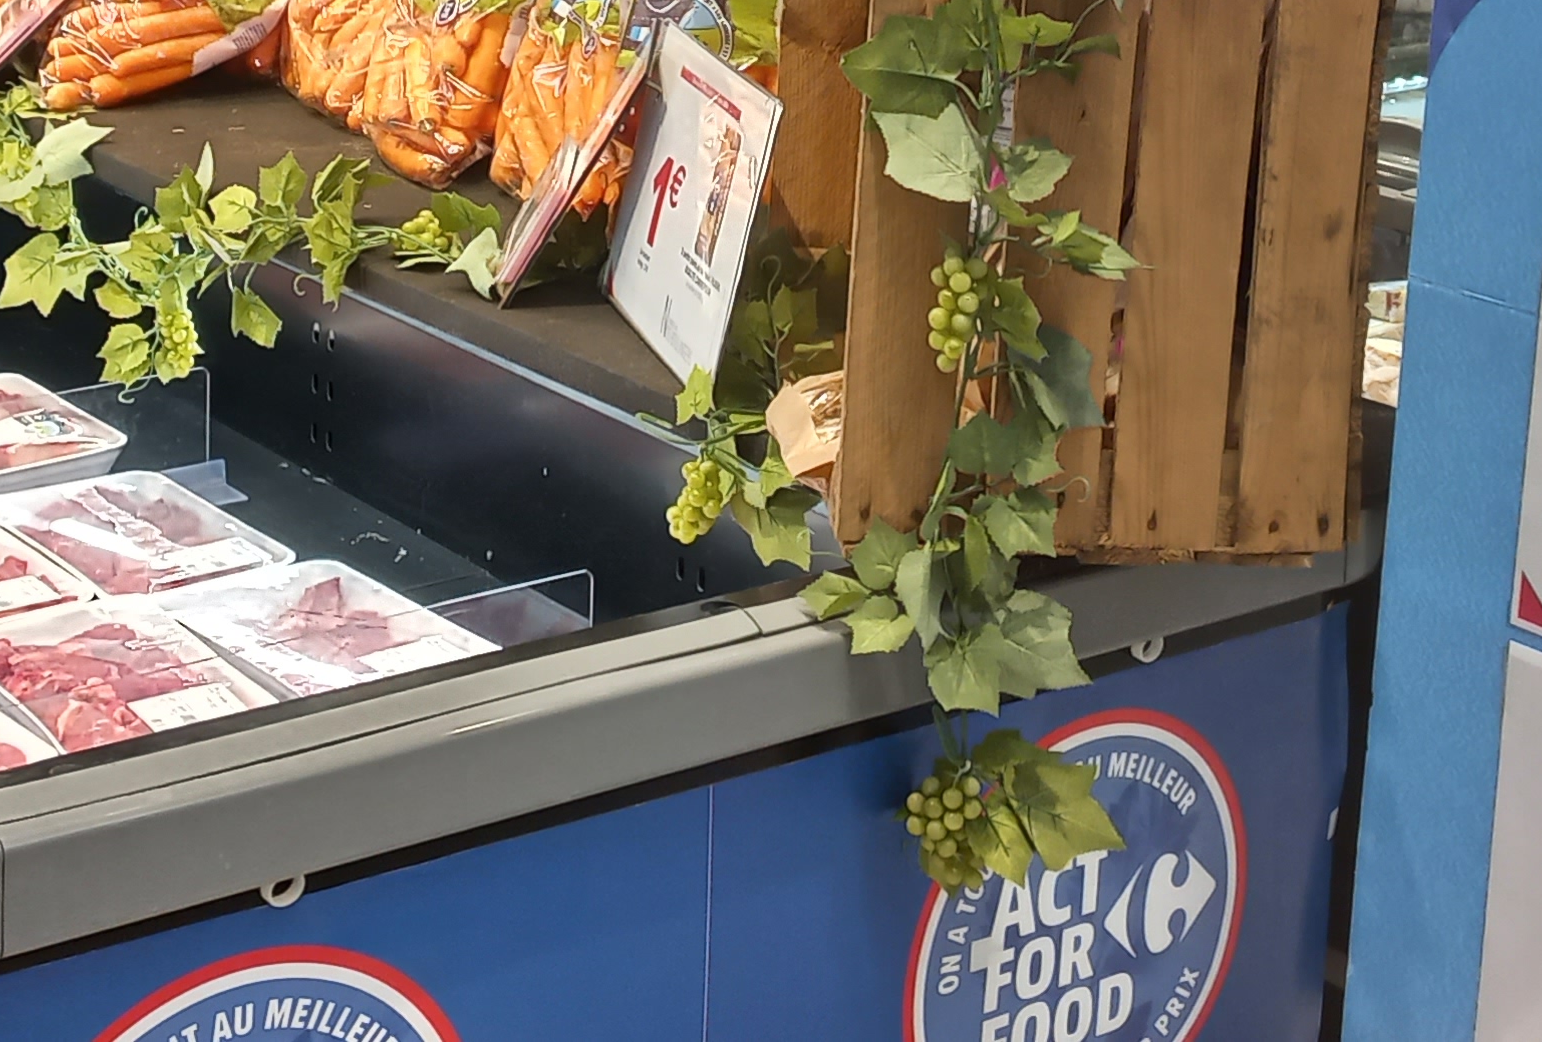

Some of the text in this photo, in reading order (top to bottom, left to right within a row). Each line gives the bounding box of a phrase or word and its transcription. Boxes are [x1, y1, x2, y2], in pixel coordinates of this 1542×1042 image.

[938, 751, 1197, 996] ON A MEILLEUR
[991, 849, 1109, 943] ACT
[982, 922, 1096, 1015] FOR
[1153, 966, 1202, 1037] PRIX
[212, 1001, 255, 1042] AU
[264, 997, 400, 1042] MEILLEU
